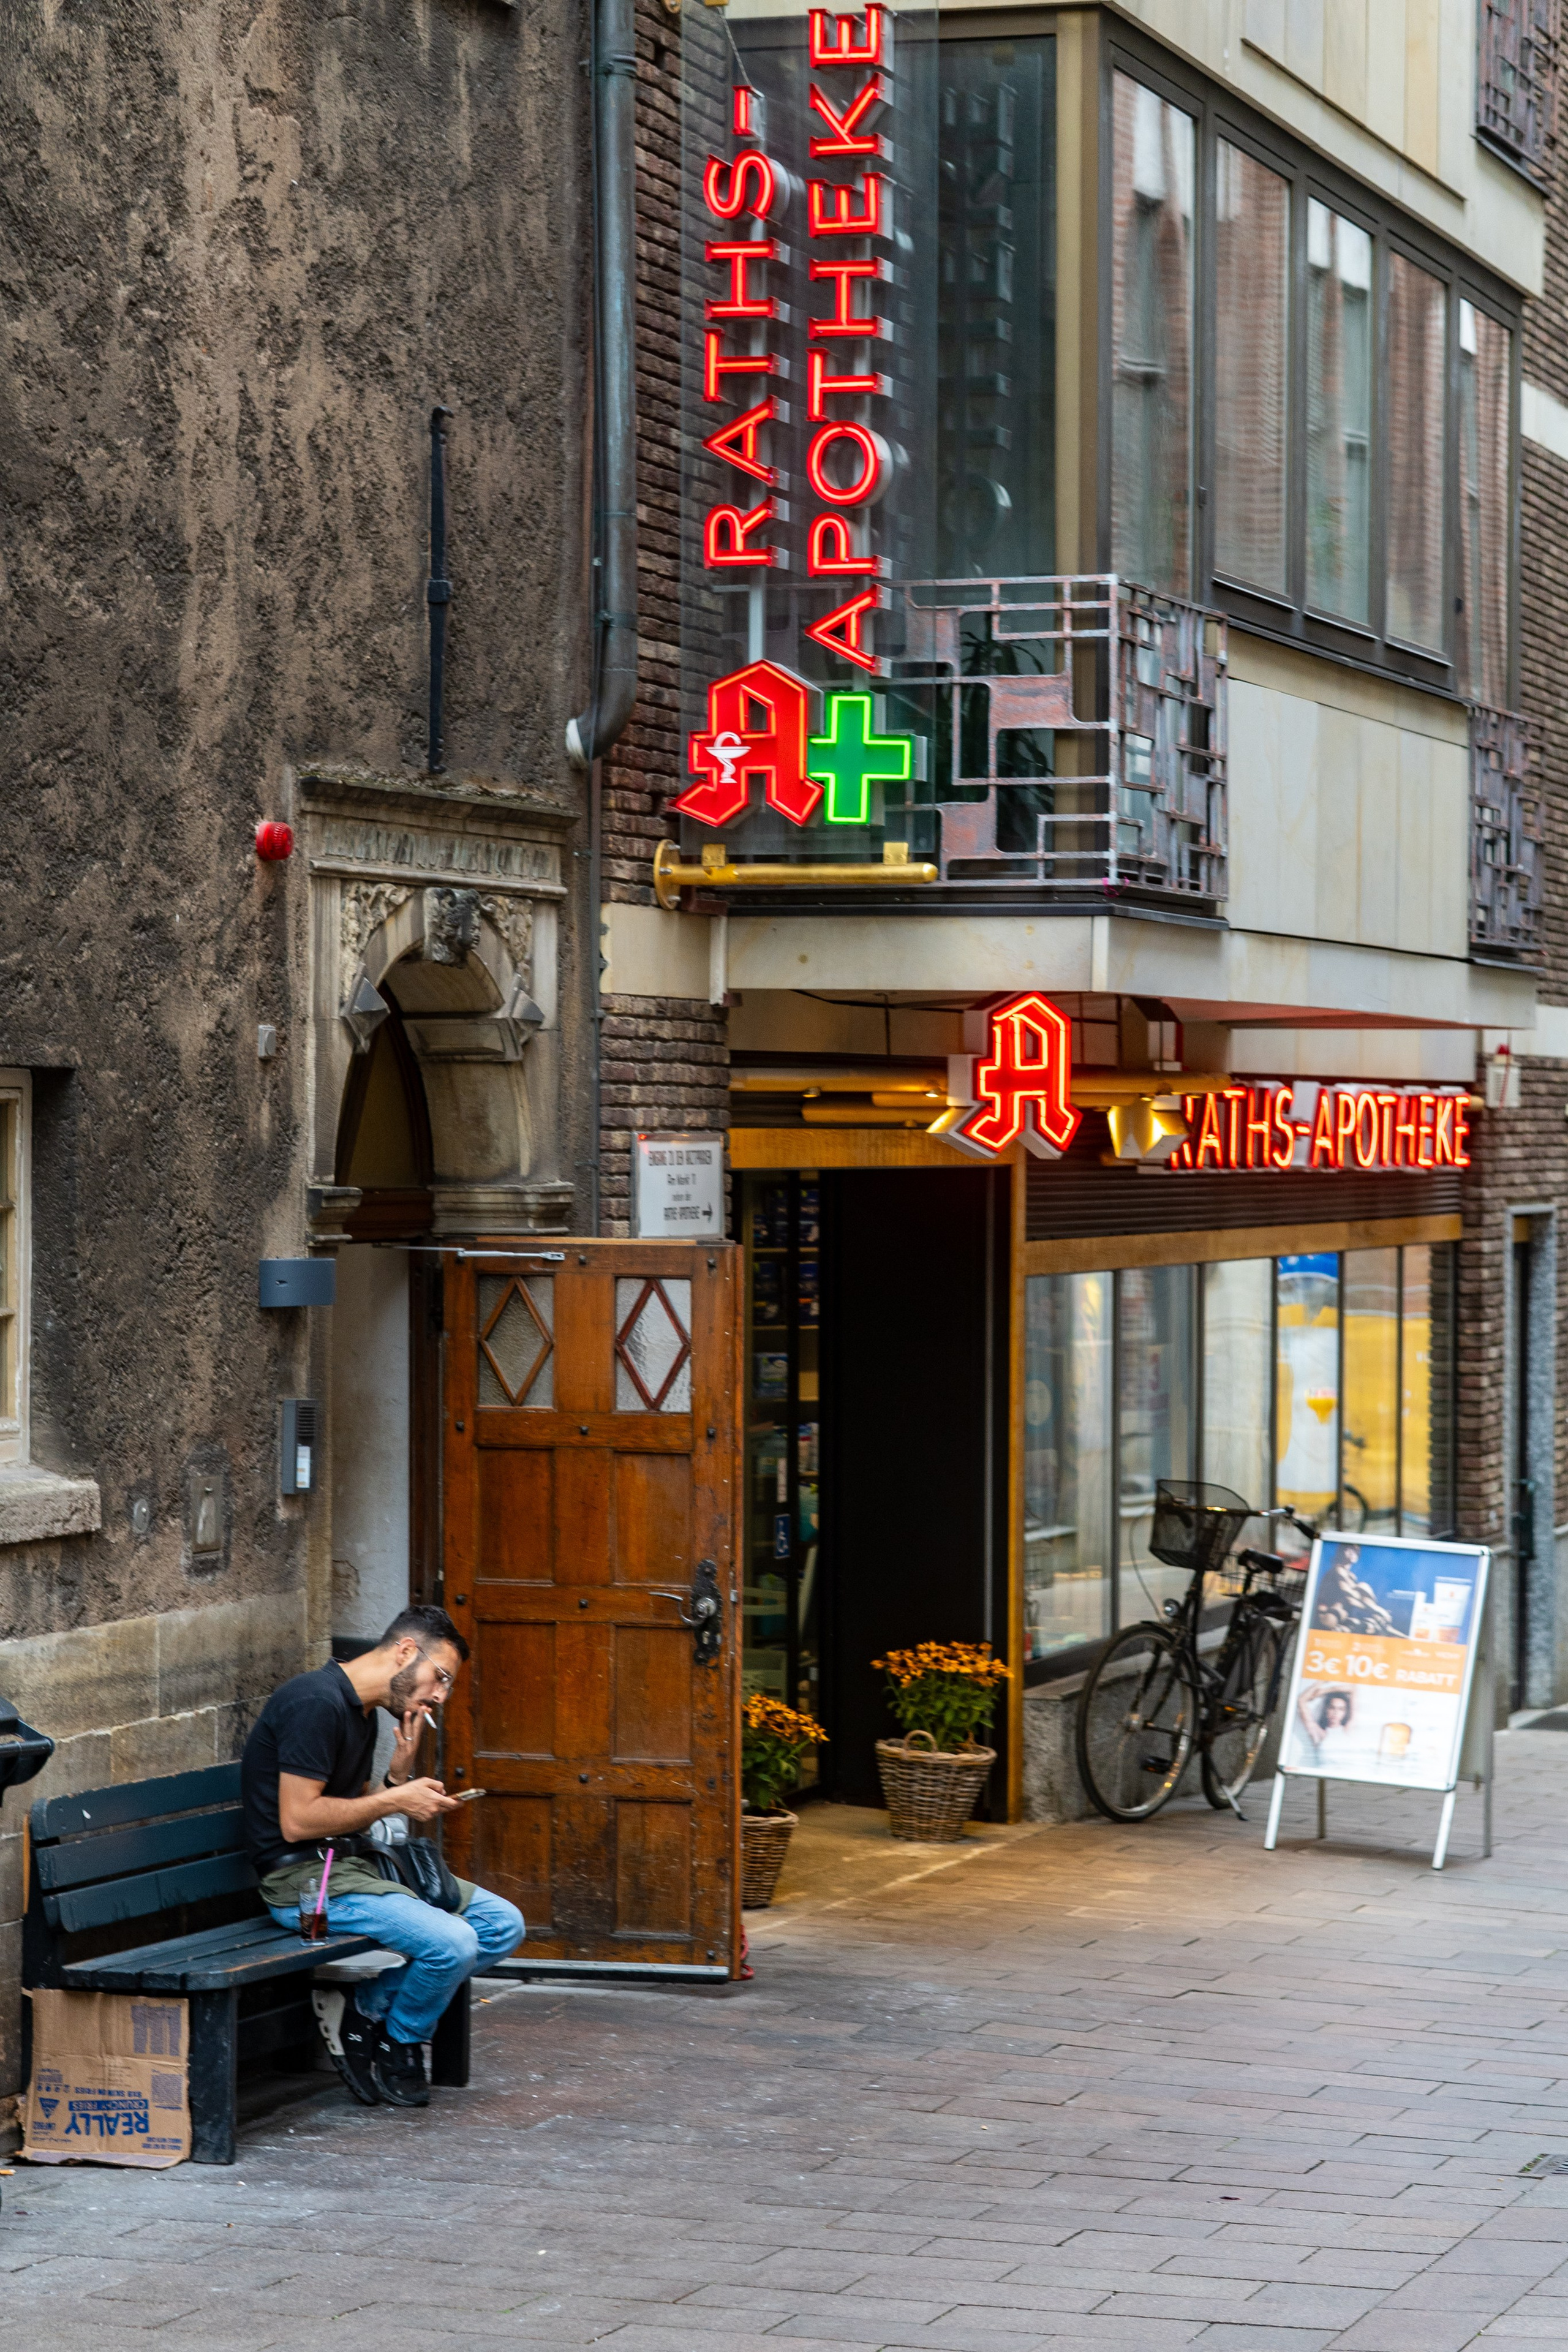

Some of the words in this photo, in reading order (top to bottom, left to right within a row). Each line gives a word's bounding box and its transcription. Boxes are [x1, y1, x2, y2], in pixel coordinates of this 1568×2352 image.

[703, 85, 784, 568] RATHS-
[805, 2, 888, 675] APOTHEKE
[1345, 1654, 1390, 1679] 10€
[1395, 1669, 1458, 1687] RABATT
[72, 2101, 98, 2110] FRIES
[64, 2111, 149, 2136] REALLY
